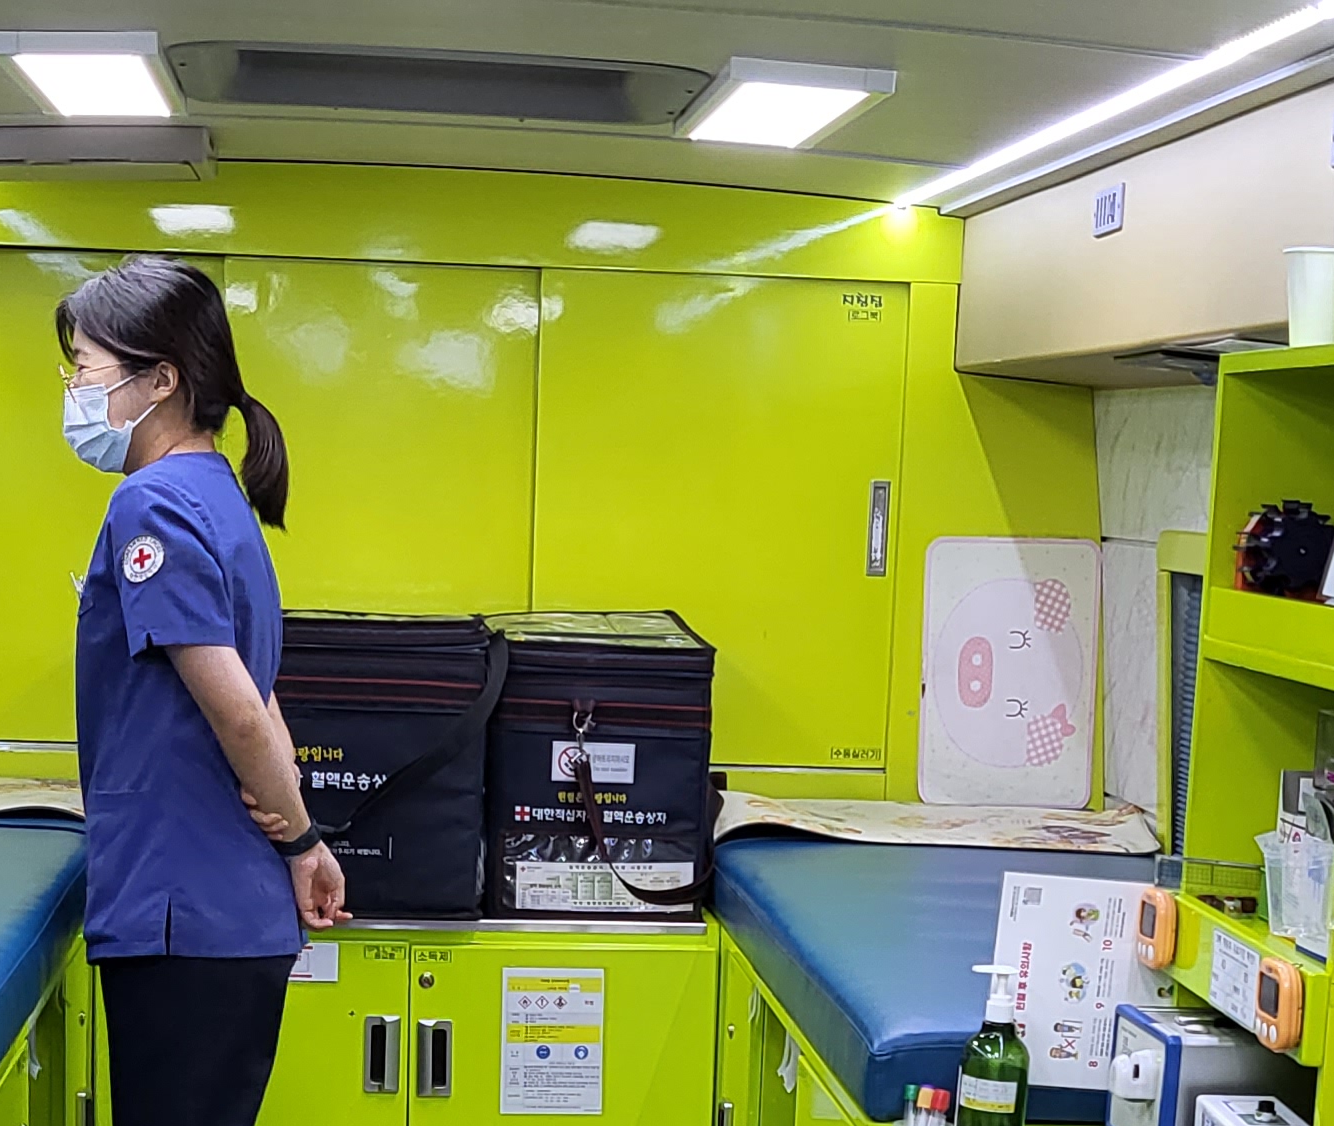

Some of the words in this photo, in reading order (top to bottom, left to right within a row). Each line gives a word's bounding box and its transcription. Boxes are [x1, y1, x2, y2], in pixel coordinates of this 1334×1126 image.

[295, 745, 344, 762] 랑입니다
[594, 792, 628, 804] 랑입니다
[532, 807, 589, 823] 대한적십자
[603, 810, 667, 825] 혈액운송상자
[1102, 939, 1113, 951] 10
[1018, 941, 1033, 979] 유의사항
[1017, 981, 1028, 991] 후
[1095, 1002, 1105, 1010] 9
[1088, 1060, 1098, 1068] 8
